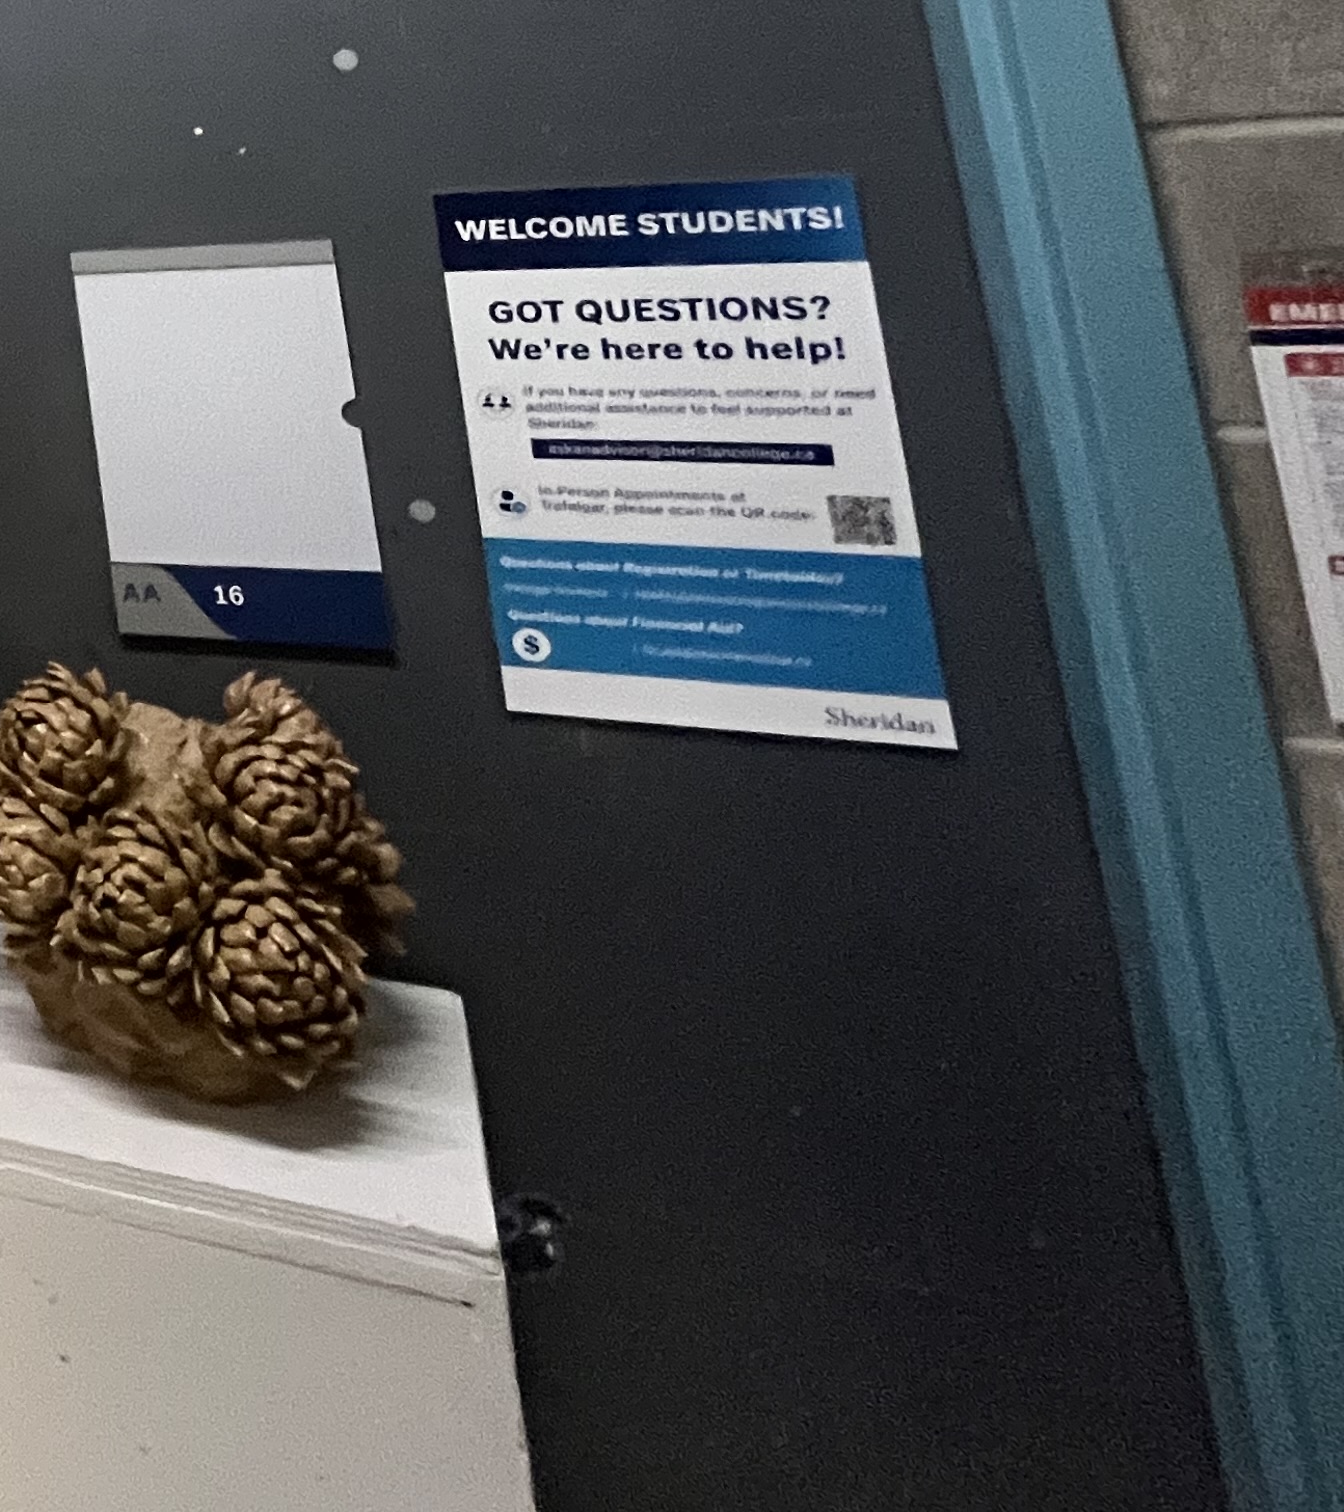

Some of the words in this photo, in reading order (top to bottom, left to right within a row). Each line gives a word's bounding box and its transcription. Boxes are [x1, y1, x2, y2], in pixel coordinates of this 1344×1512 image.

[455, 214, 629, 241] WELCOME
[637, 205, 844, 236] STUDENTS!
[488, 300, 564, 323] GOT
[575, 295, 830, 325] QUESTIONS?
[488, 338, 590, 360] We're
[601, 337, 683, 360] here
[694, 338, 733, 360] to
[745, 336, 845, 365] help!
[526, 402, 599, 413] additional
[745, 405, 831, 416] supported
[123, 583, 161, 603] AA
[213, 585, 245, 606] 16
[824, 707, 935, 734] Sheridan
